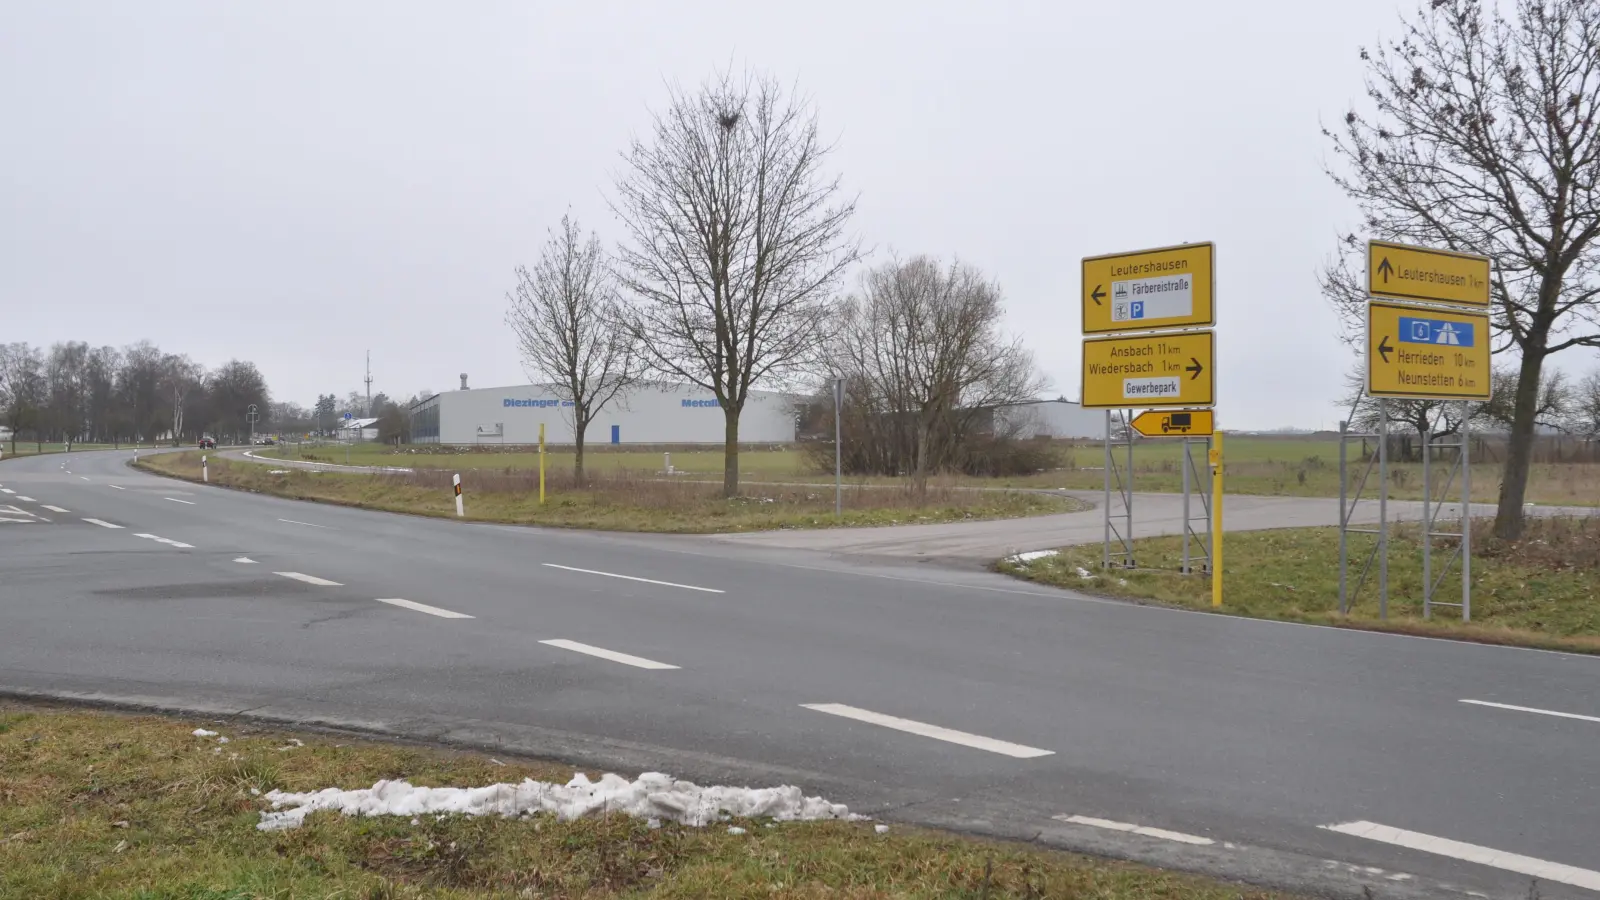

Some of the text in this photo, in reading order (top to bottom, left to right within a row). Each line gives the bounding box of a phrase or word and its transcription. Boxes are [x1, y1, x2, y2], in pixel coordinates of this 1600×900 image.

[1110, 260, 1188, 276] Leutershausen
[1398, 265, 1466, 286] Leutershausen
[1132, 278, 1188, 295] Färbereistraße
[1133, 304, 1140, 316] P
[1110, 344, 1153, 358] Ansbach
[1158, 344, 1166, 354] 11
[1398, 348, 1475, 368] Herrieden 10 km
[1089, 360, 1180, 374] Wiedersbach 1 km
[1398, 370, 1454, 386] Neunstetten
[1464, 378, 1476, 388] km
[1126, 382, 1176, 396] Gewerbepark
[504, 399, 559, 408] Diezinger
